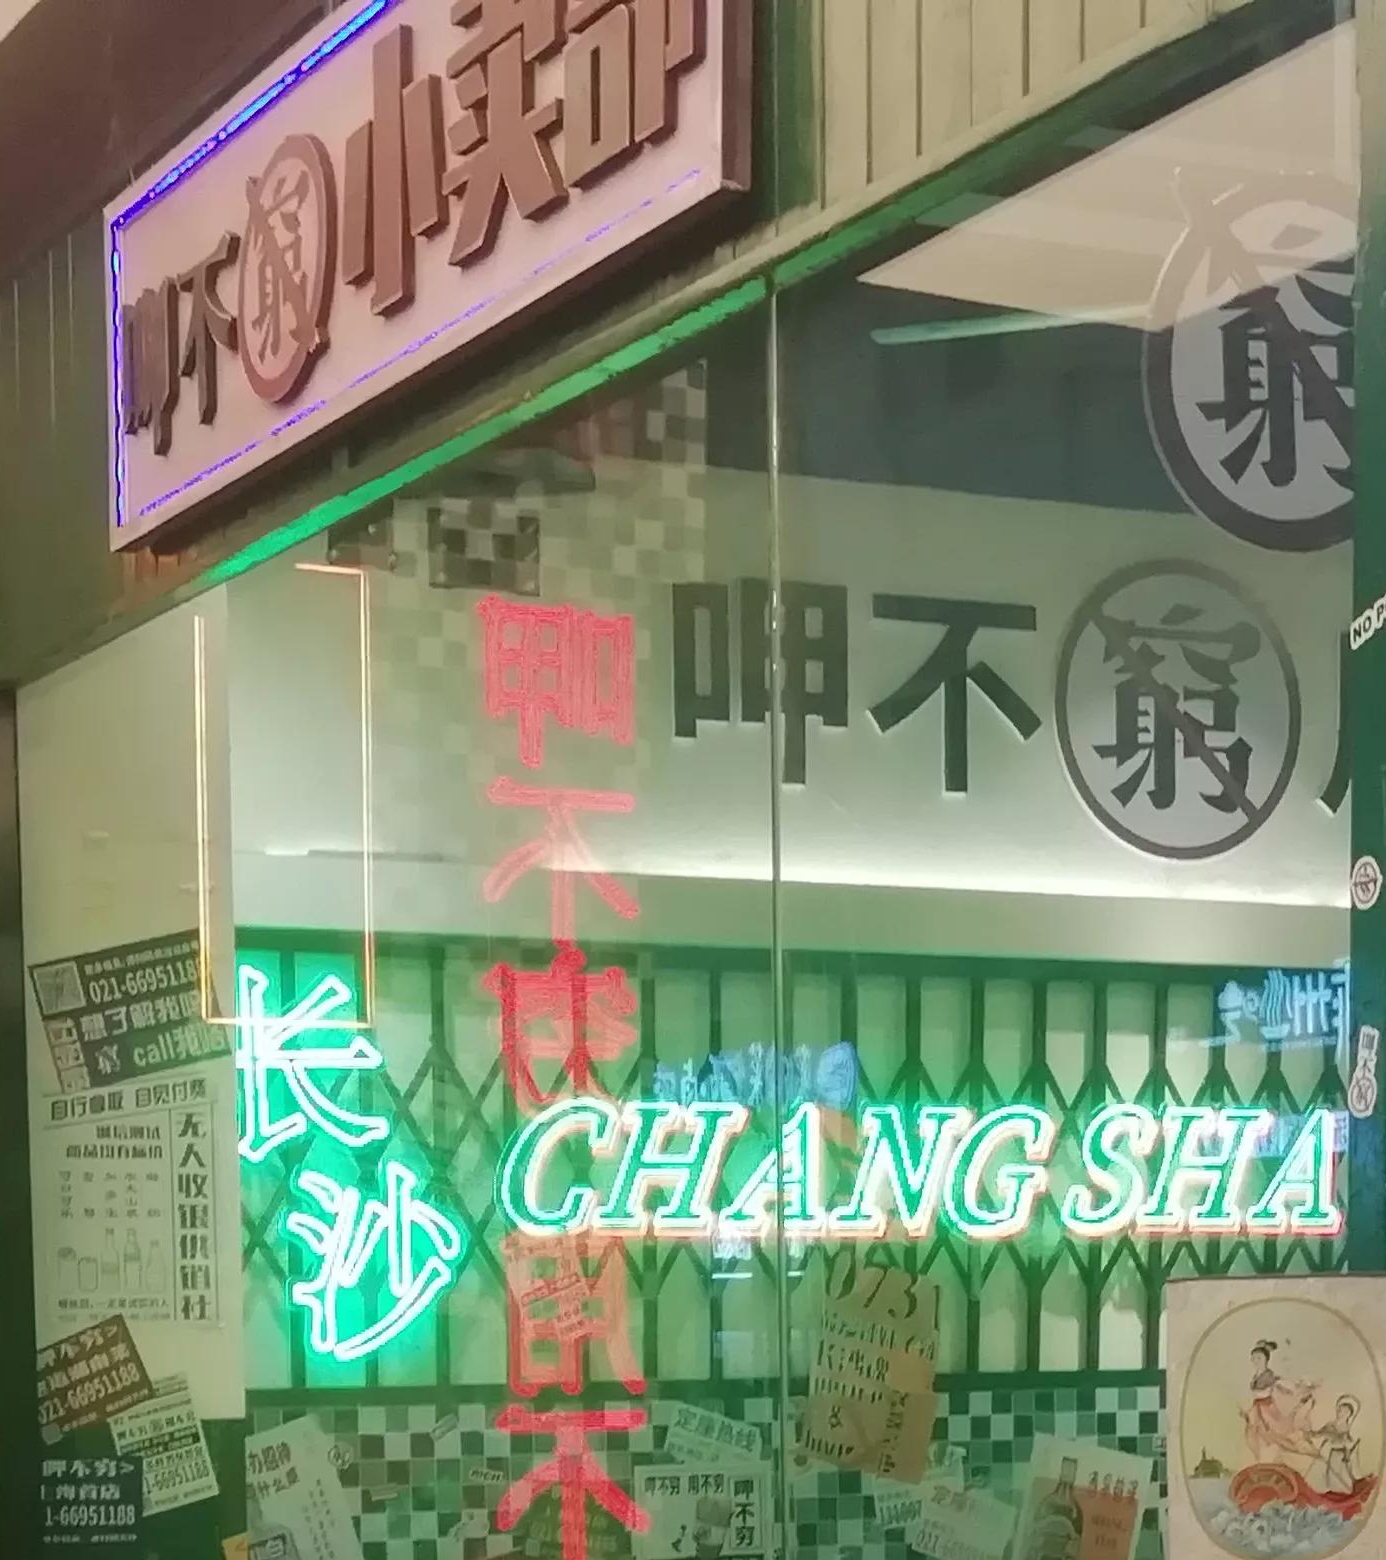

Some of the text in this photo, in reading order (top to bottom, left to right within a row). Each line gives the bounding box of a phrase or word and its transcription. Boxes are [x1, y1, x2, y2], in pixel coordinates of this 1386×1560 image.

[1351, 612, 1374, 642] NO
[89, 960, 205, 1004] 021-6695118
[238, 963, 463, 1362] 长沙
[500, 1097, 1346, 1238] CHANG SHA
